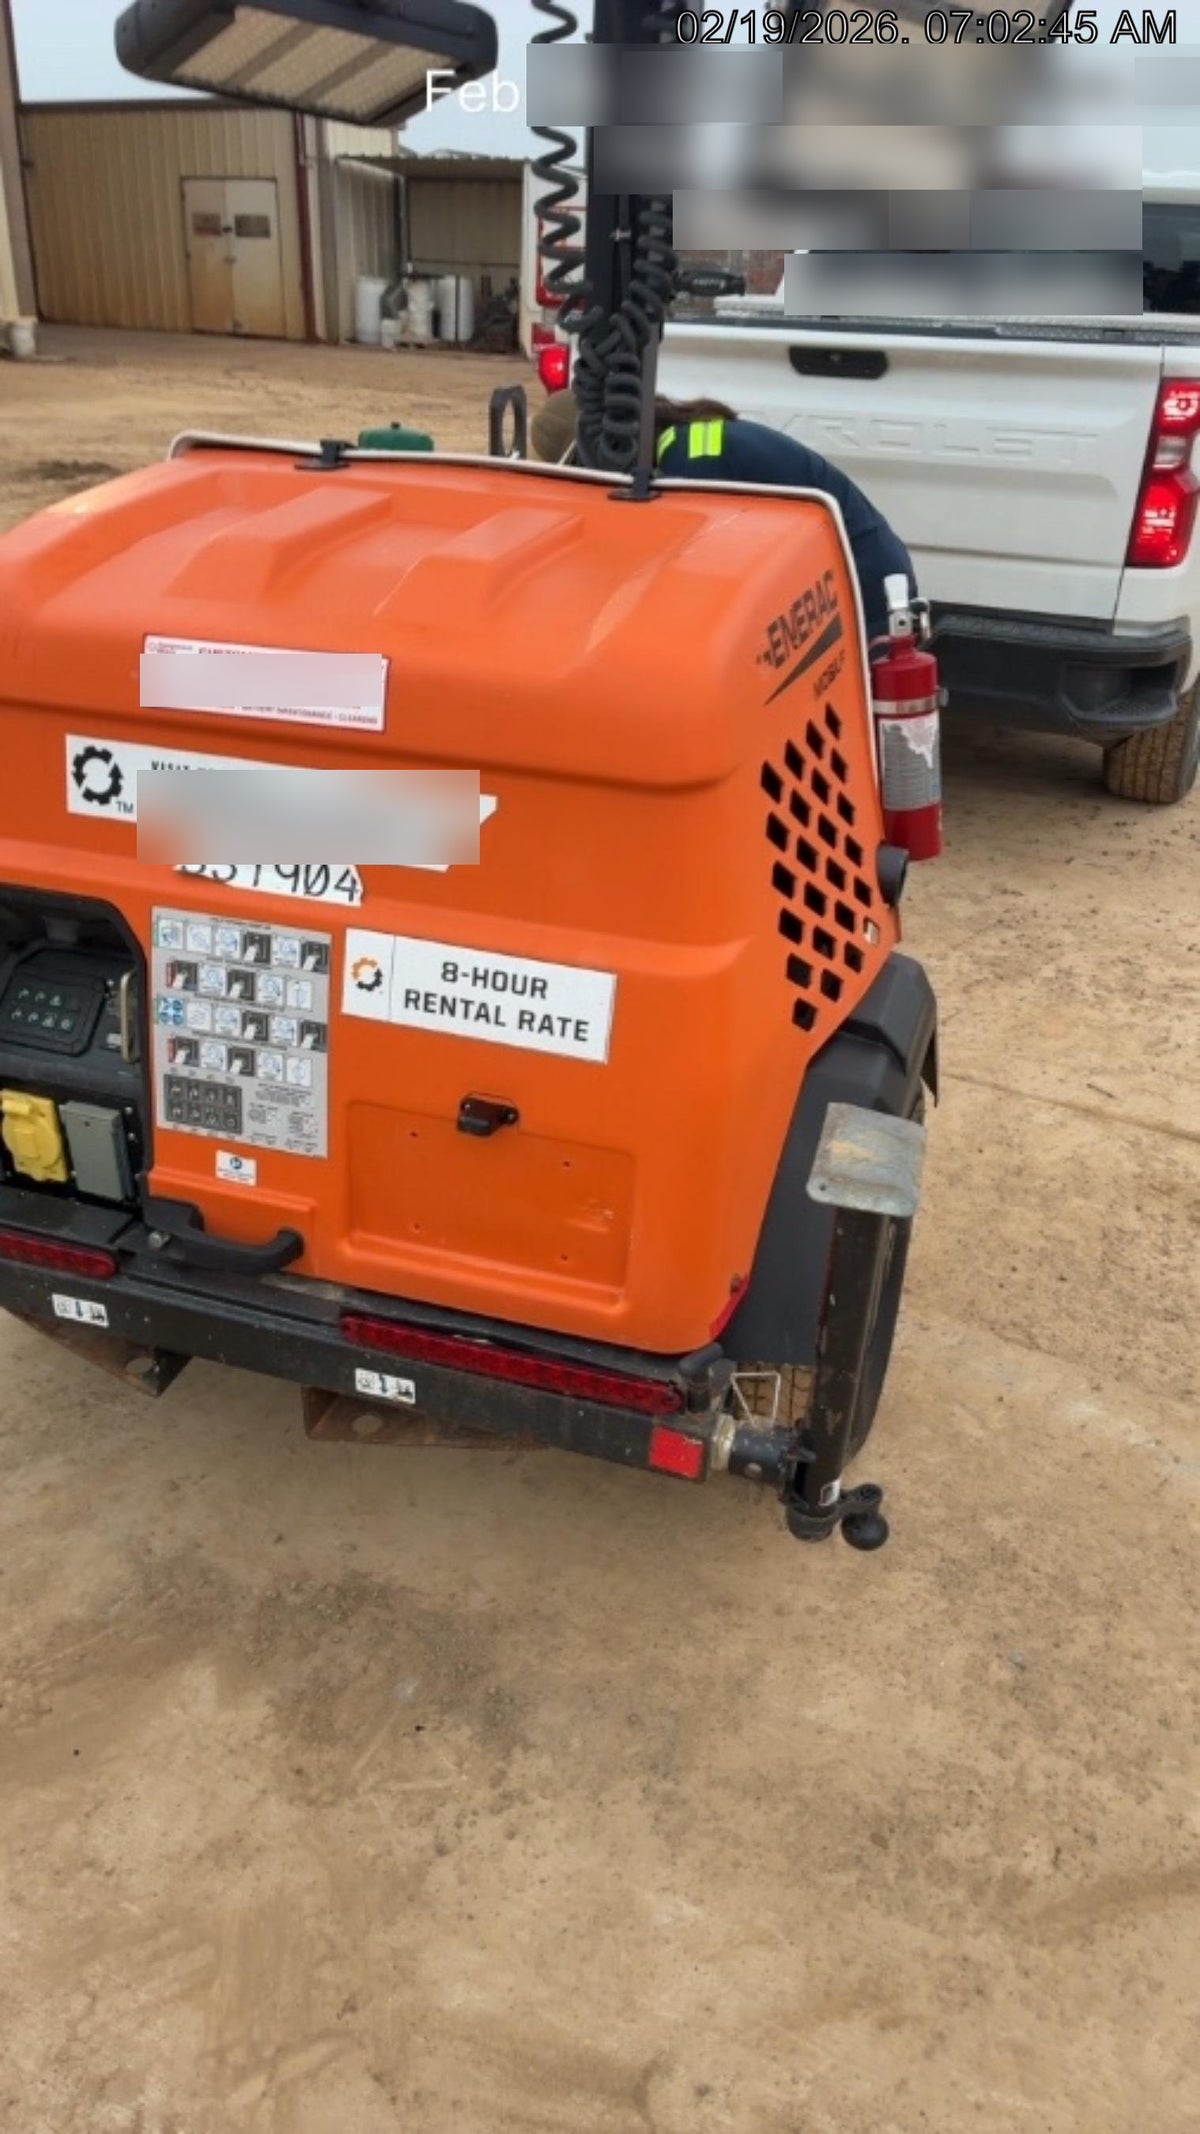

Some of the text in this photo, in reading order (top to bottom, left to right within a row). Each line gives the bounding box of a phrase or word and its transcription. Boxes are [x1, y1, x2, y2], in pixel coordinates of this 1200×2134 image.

[116, 800, 134, 813] TM
[441, 961, 548, 999] 8-HOUR
[404, 988, 590, 1042] RENTAL RATE
